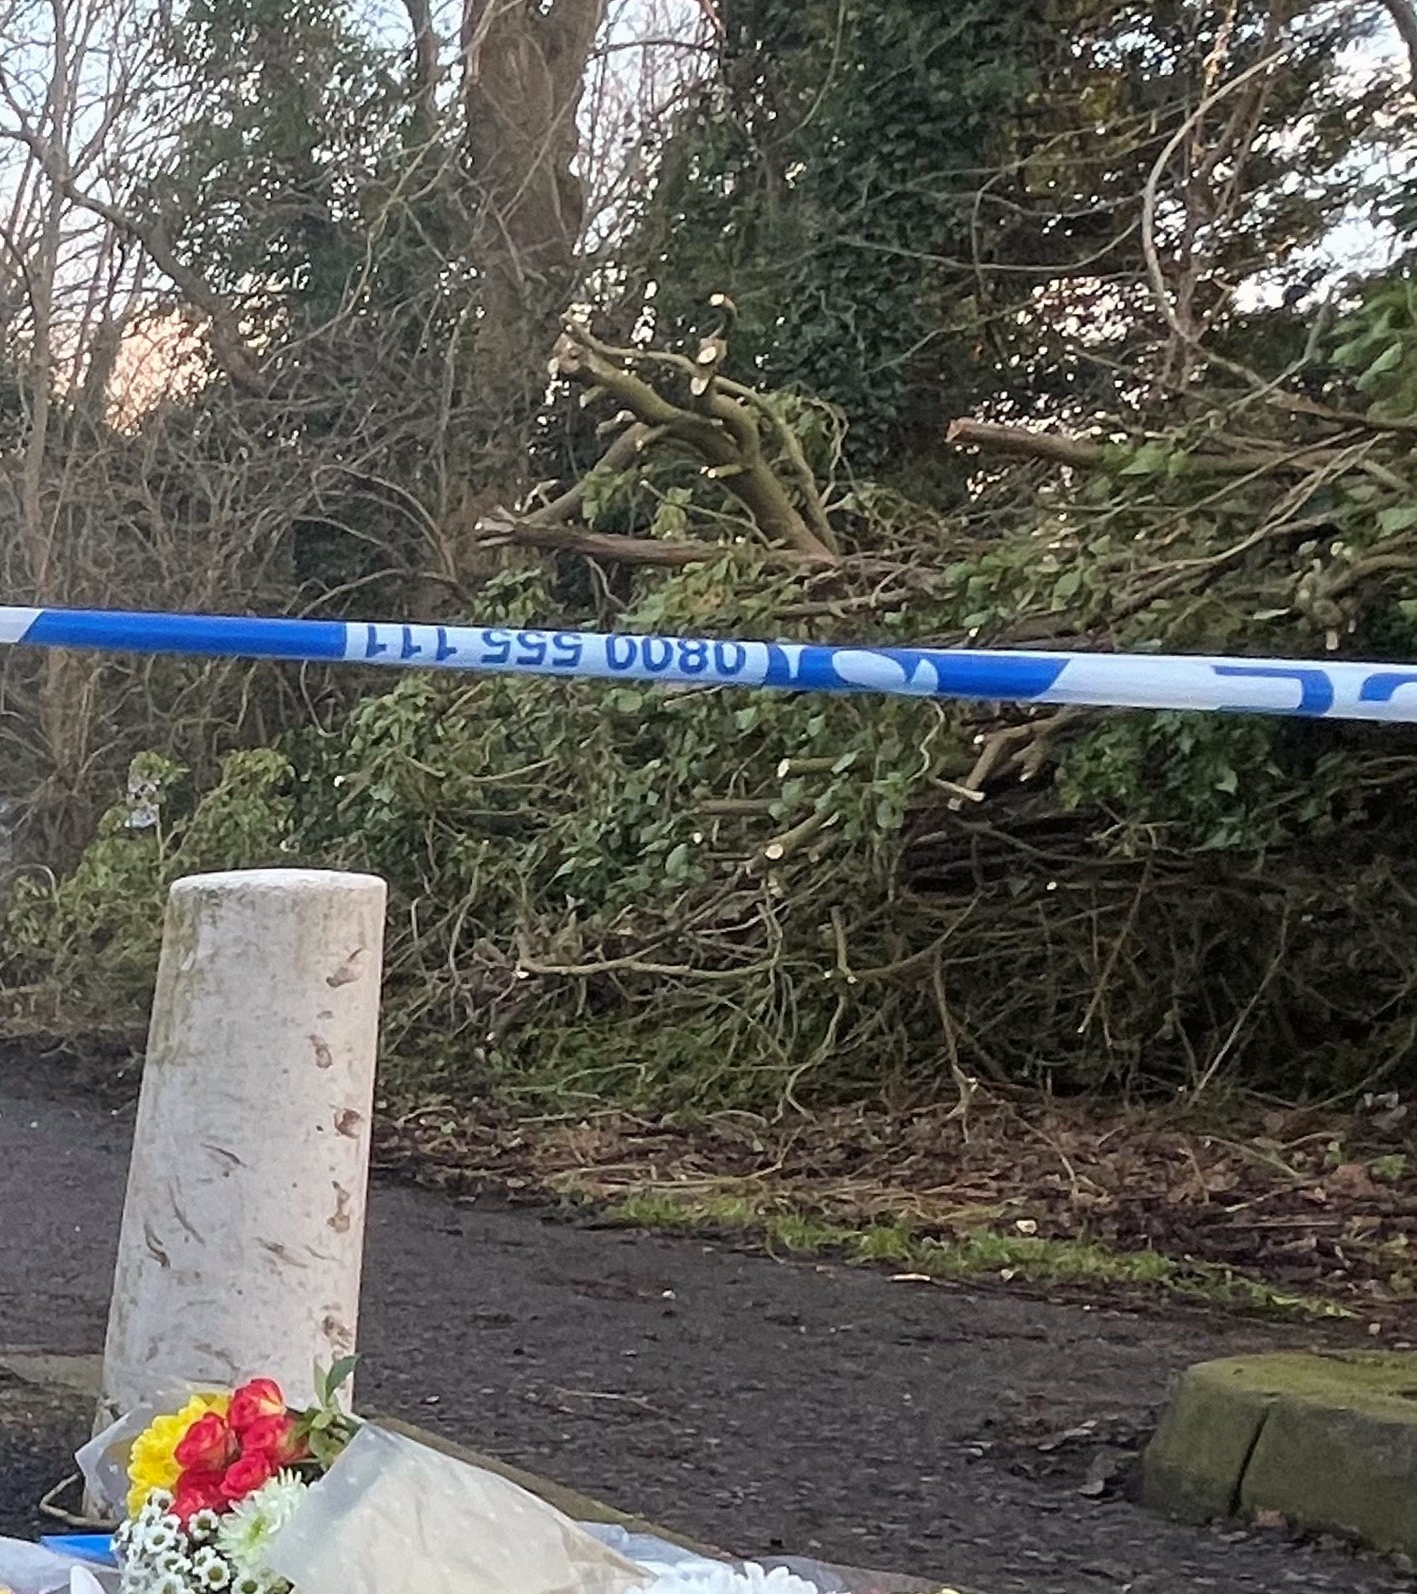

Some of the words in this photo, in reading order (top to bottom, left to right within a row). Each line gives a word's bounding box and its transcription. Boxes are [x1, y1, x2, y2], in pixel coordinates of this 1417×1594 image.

[365, 622, 460, 661] 111
[480, 625, 579, 669] 555
[605, 632, 747, 678] 0800
